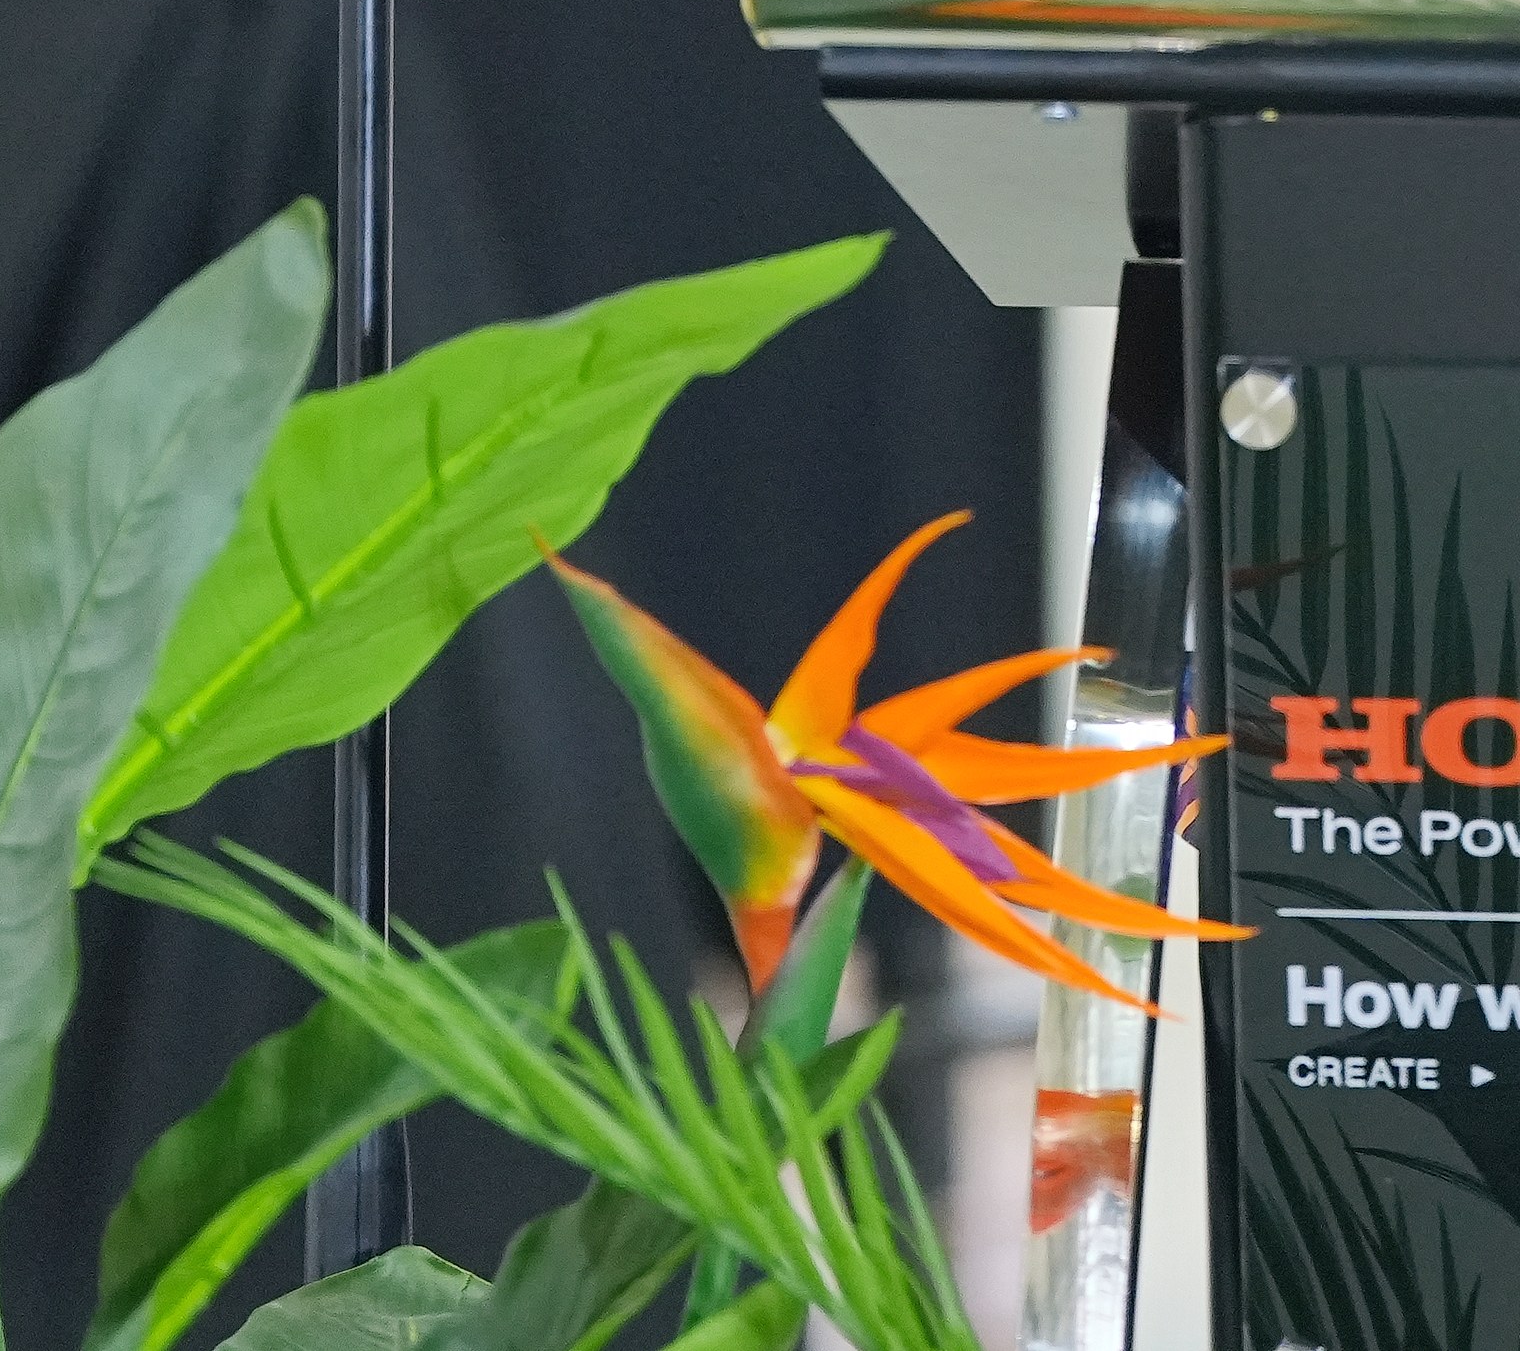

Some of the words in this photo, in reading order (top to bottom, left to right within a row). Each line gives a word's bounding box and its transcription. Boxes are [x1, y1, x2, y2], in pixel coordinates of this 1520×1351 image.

[1273, 805, 1403, 856] The
[1285, 964, 1462, 1030] How
[1288, 1055, 1440, 1090] CREATE
